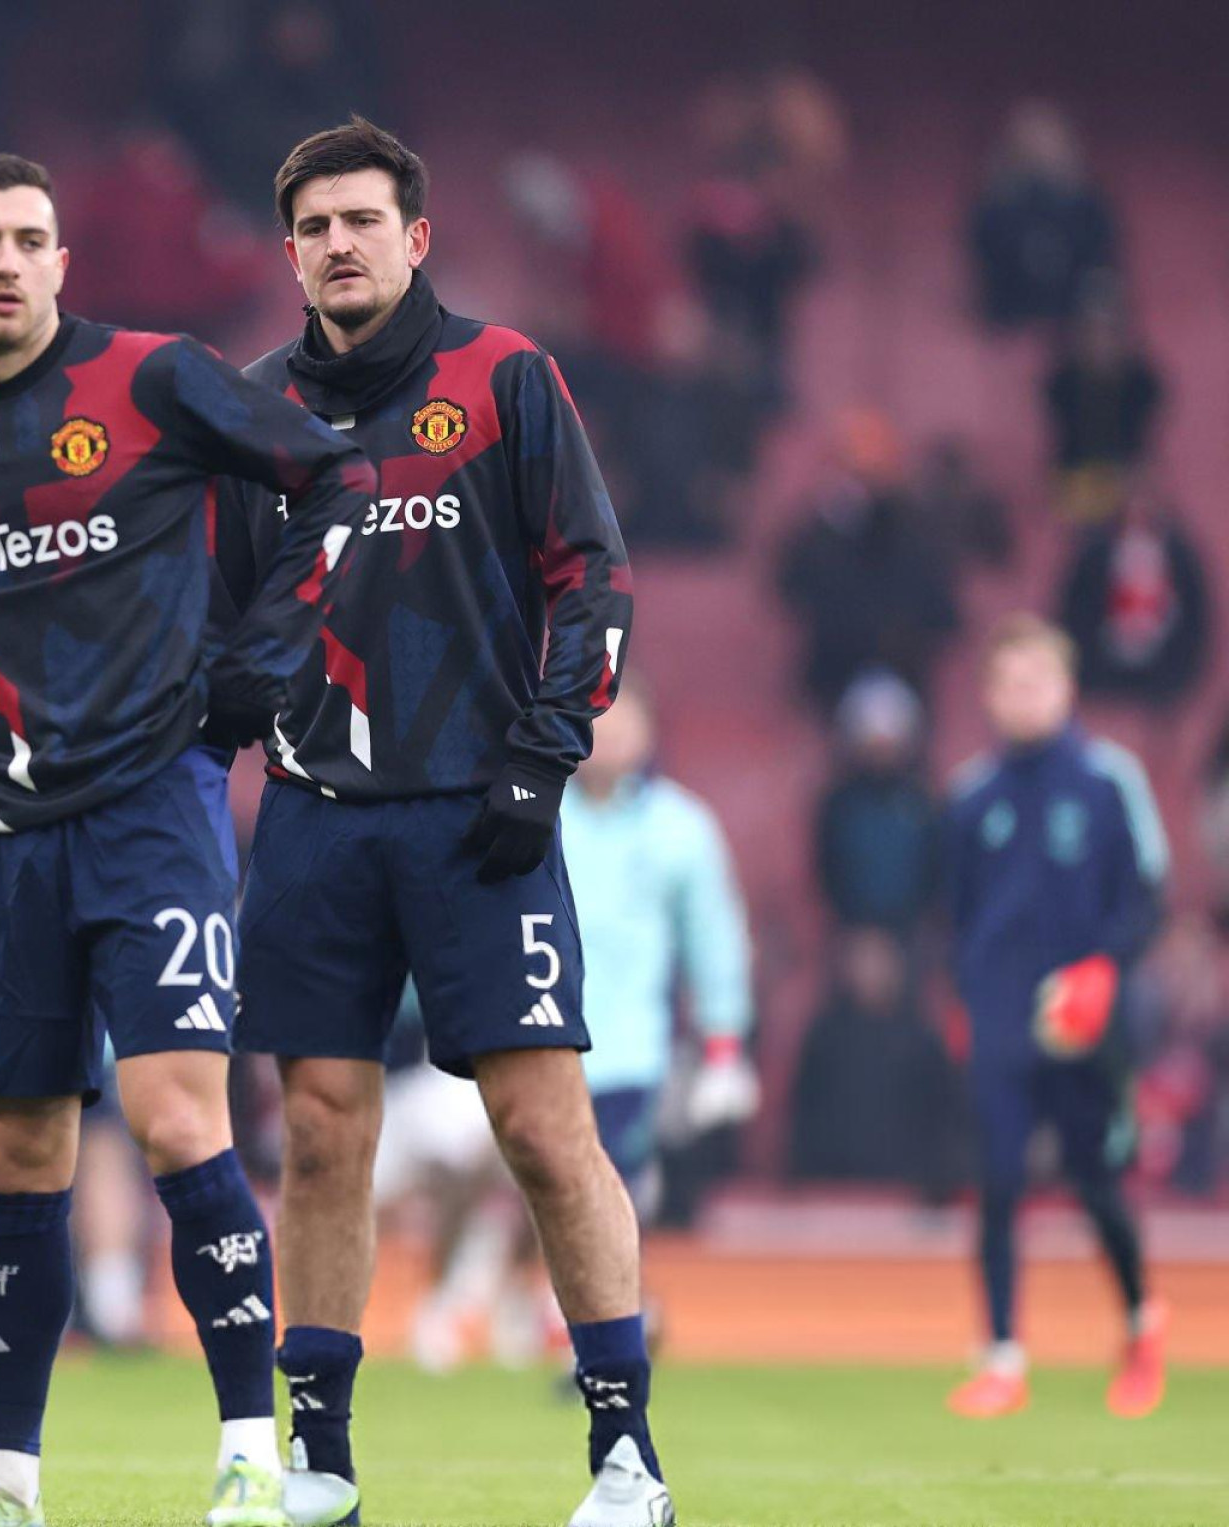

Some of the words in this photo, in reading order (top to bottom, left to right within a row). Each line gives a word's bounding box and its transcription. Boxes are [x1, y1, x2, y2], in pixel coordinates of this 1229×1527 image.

[360, 493, 461, 536] ezos
[152, 907, 235, 992] 20
[520, 913, 562, 990] 5
